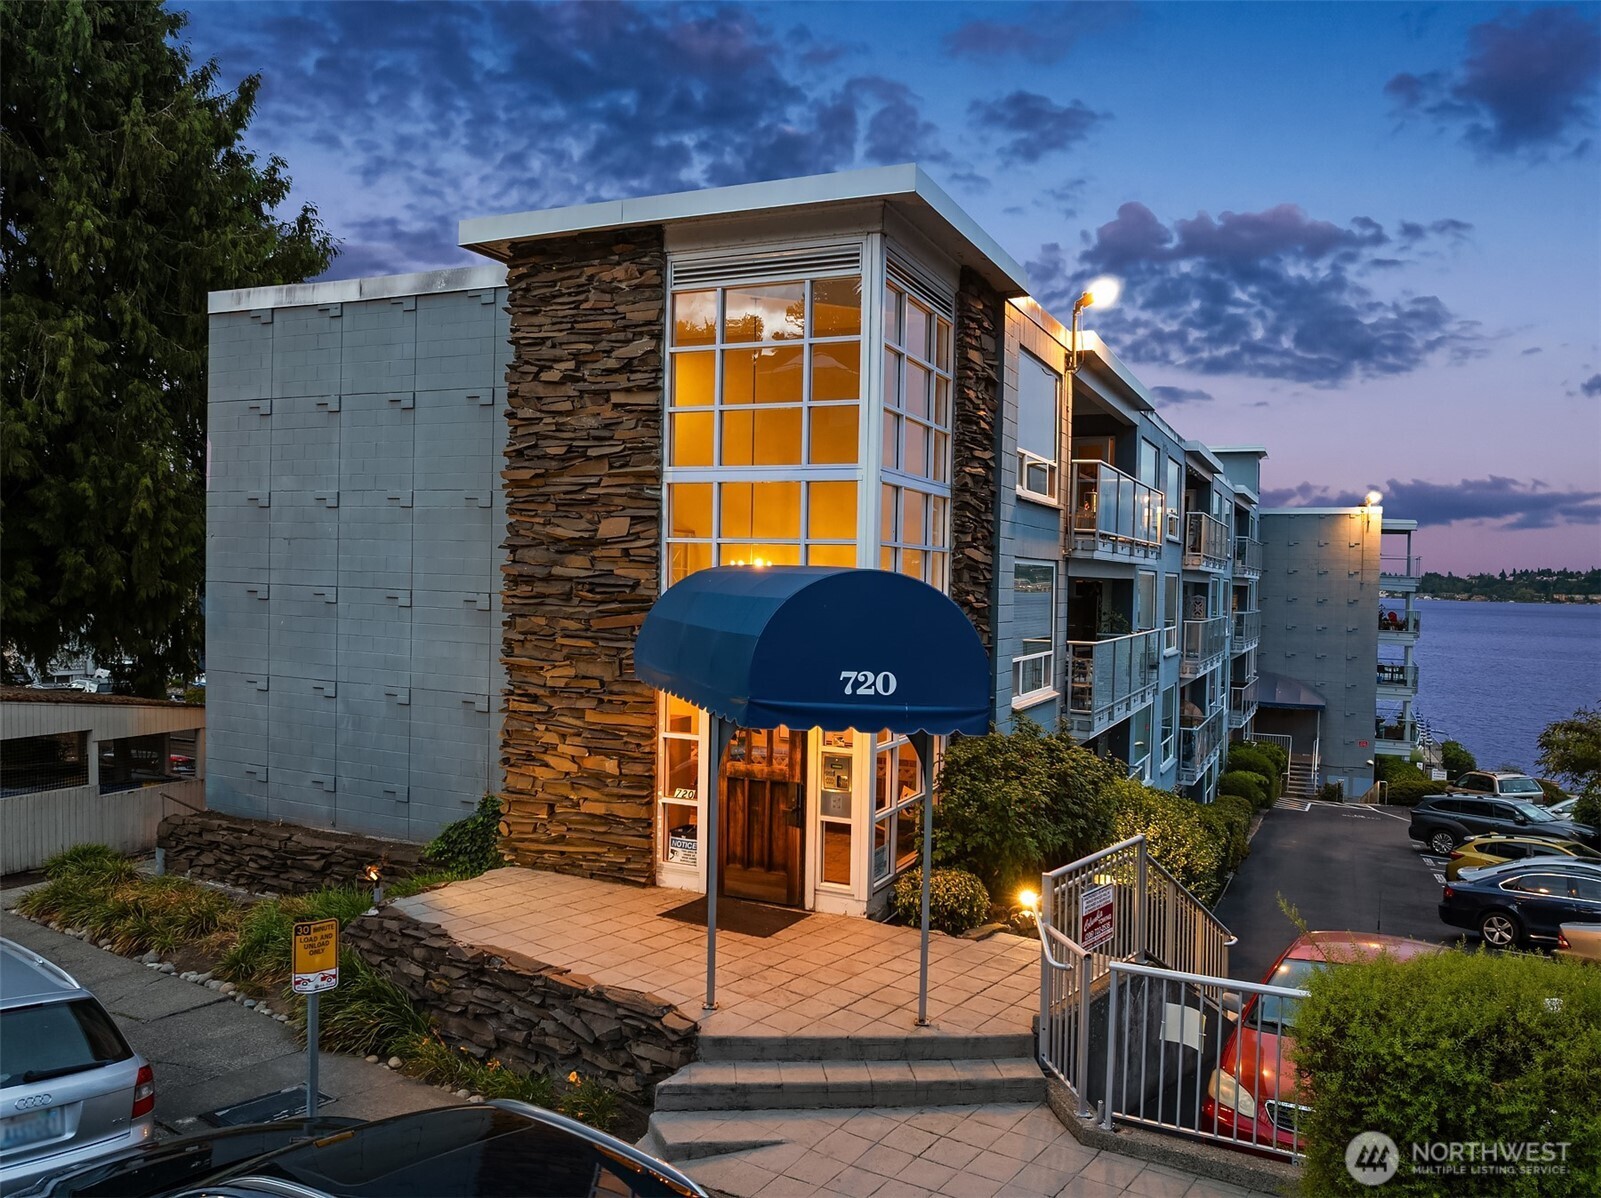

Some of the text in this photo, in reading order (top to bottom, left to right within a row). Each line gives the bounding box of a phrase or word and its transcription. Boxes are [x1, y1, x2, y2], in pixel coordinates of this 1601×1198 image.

[840, 671, 897, 696] 720
[676, 789, 694, 798] 720
[671, 840, 697, 850] NOTICE
[297, 924, 334, 935] 30 MINUTE
[304, 940, 330, 950] UNLOAD
[308, 948, 326, 956] ONLY
